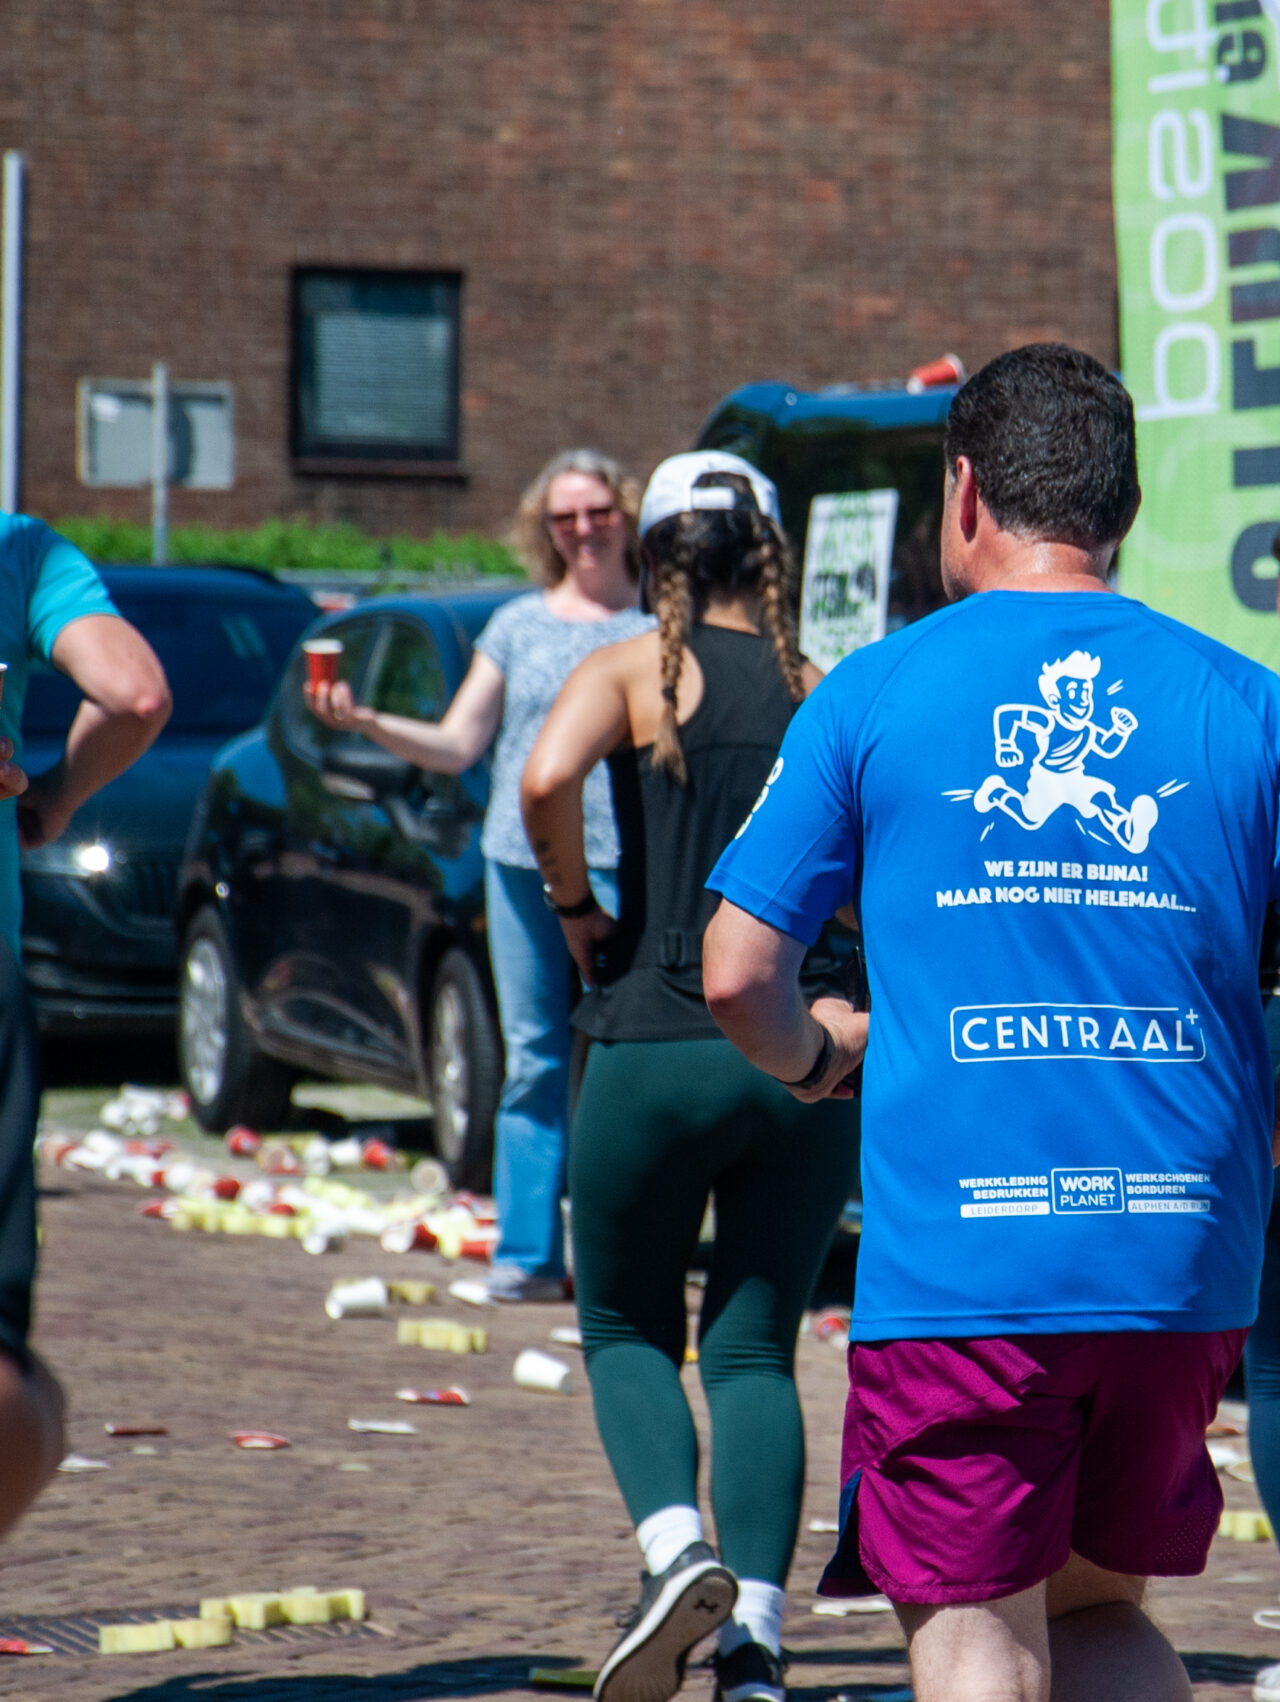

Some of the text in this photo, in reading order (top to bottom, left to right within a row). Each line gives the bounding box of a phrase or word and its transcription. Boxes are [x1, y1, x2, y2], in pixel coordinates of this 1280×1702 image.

[985, 860, 1149, 882] WE ZIJN ER BIJNA!
[936, 886, 1197, 912] MAAR NOG NIET HELEMAAL...
[959, 1175, 1048, 1188] WERKKLEDING
[1060, 1175, 1115, 1192] WORK
[1125, 1173, 1211, 1183] WERKSCHOENEN
[973, 1188, 1049, 1200] BEDRUKKEN
[1126, 1184, 1186, 1195] BORDUREN
[1060, 1193, 1116, 1207] PLANET
[971, 1204, 1038, 1216] LEIDERDORP
[1131, 1202, 1170, 1211] ALPHEN
